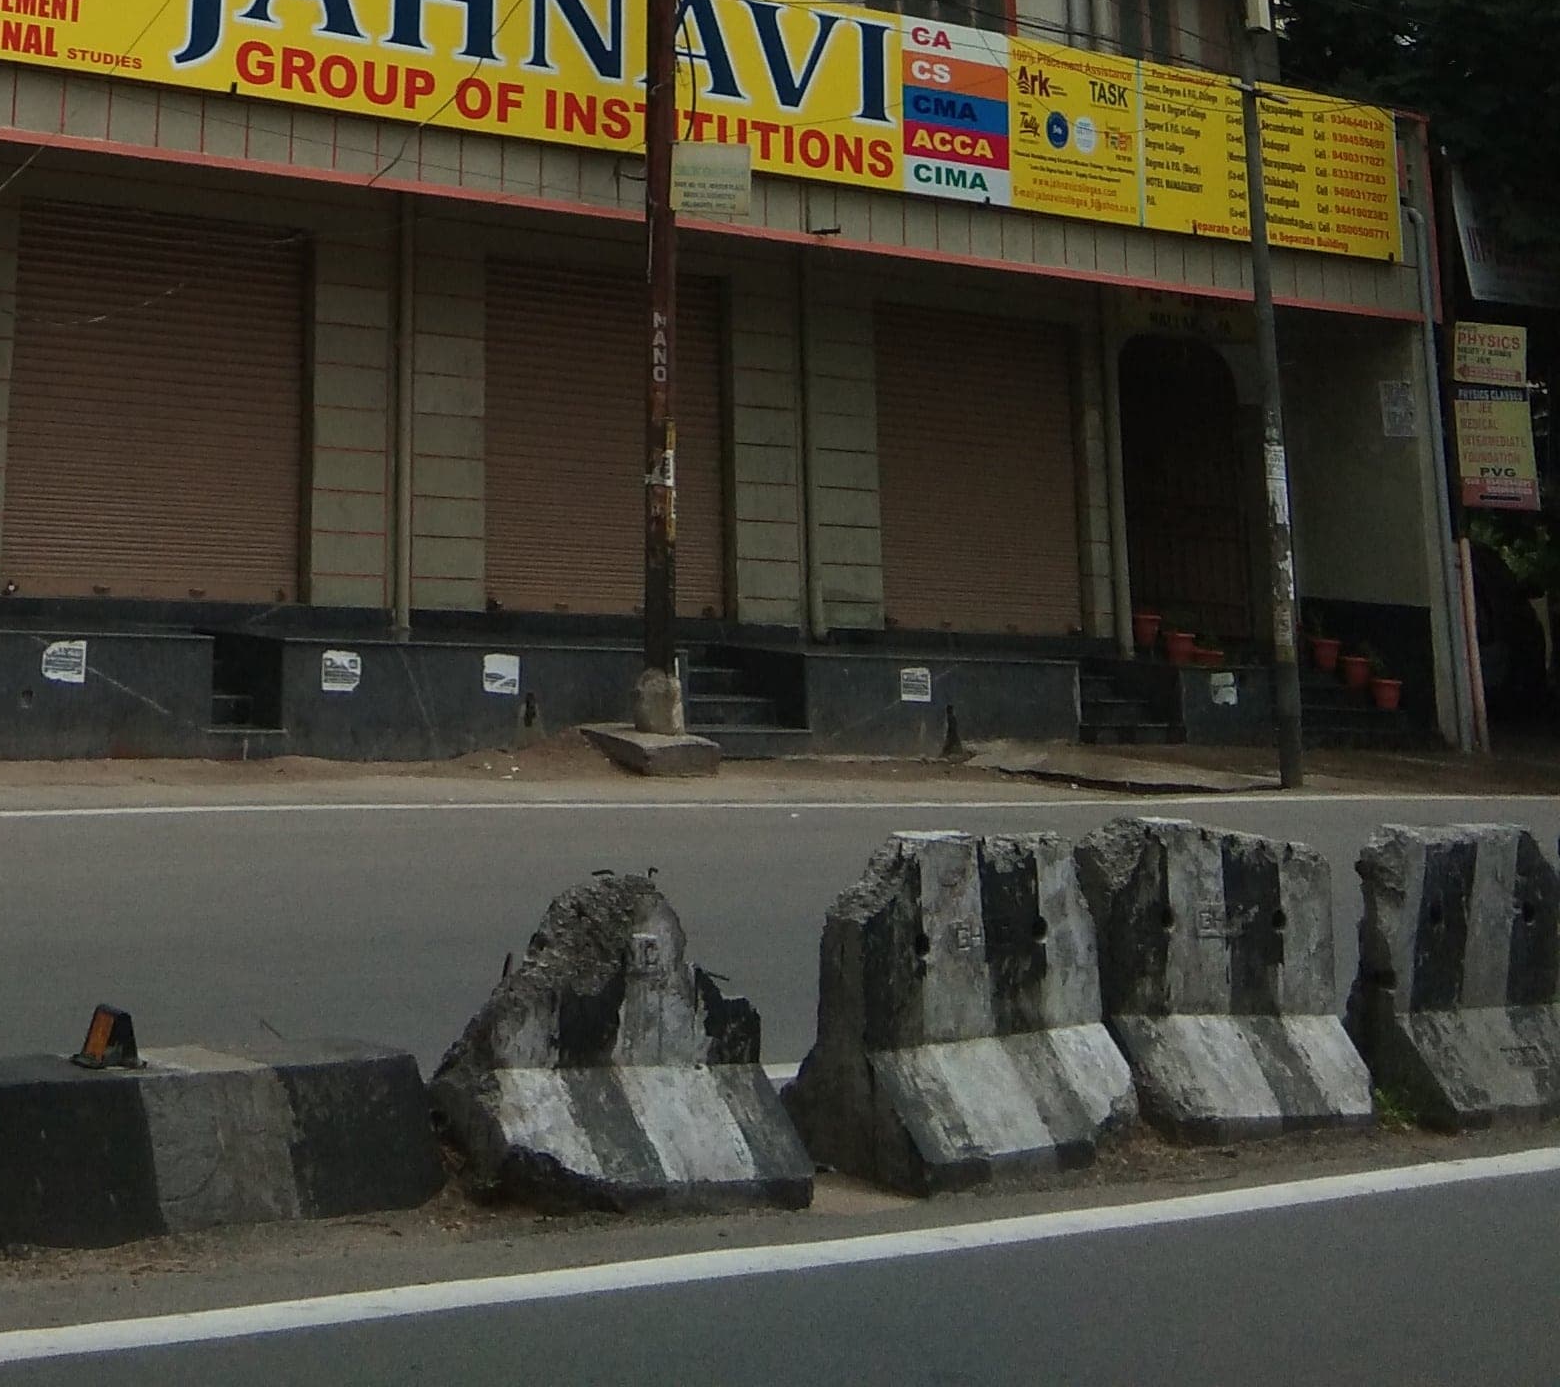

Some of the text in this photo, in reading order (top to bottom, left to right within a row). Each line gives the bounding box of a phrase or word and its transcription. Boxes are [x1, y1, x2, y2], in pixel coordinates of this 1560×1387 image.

[911, 27, 952, 50] CA
[67, 48, 143, 70] STUDIES
[1037, 52, 1083, 75] Placement
[911, 60, 951, 84] CS
[1017, 66, 1051, 97] Ark
[1089, 81, 1129, 108] TASK
[235, 41, 894, 179] GROUP OF INSITUTIONS
[913, 95, 978, 122] CMA
[1019, 112, 1040, 140] Tally
[912, 129, 993, 159] ACCA
[914, 163, 988, 192] CIMA
[1145, 175, 1163, 188] HOTEL
[1165, 179, 1202, 194] MANAGEMENT
[1279, 232, 1315, 246] Separate
[1457, 334, 1521, 350] PHYSICS
[1458, 388, 1490, 400] PHYSICS
[1480, 467, 1517, 477] PVG
